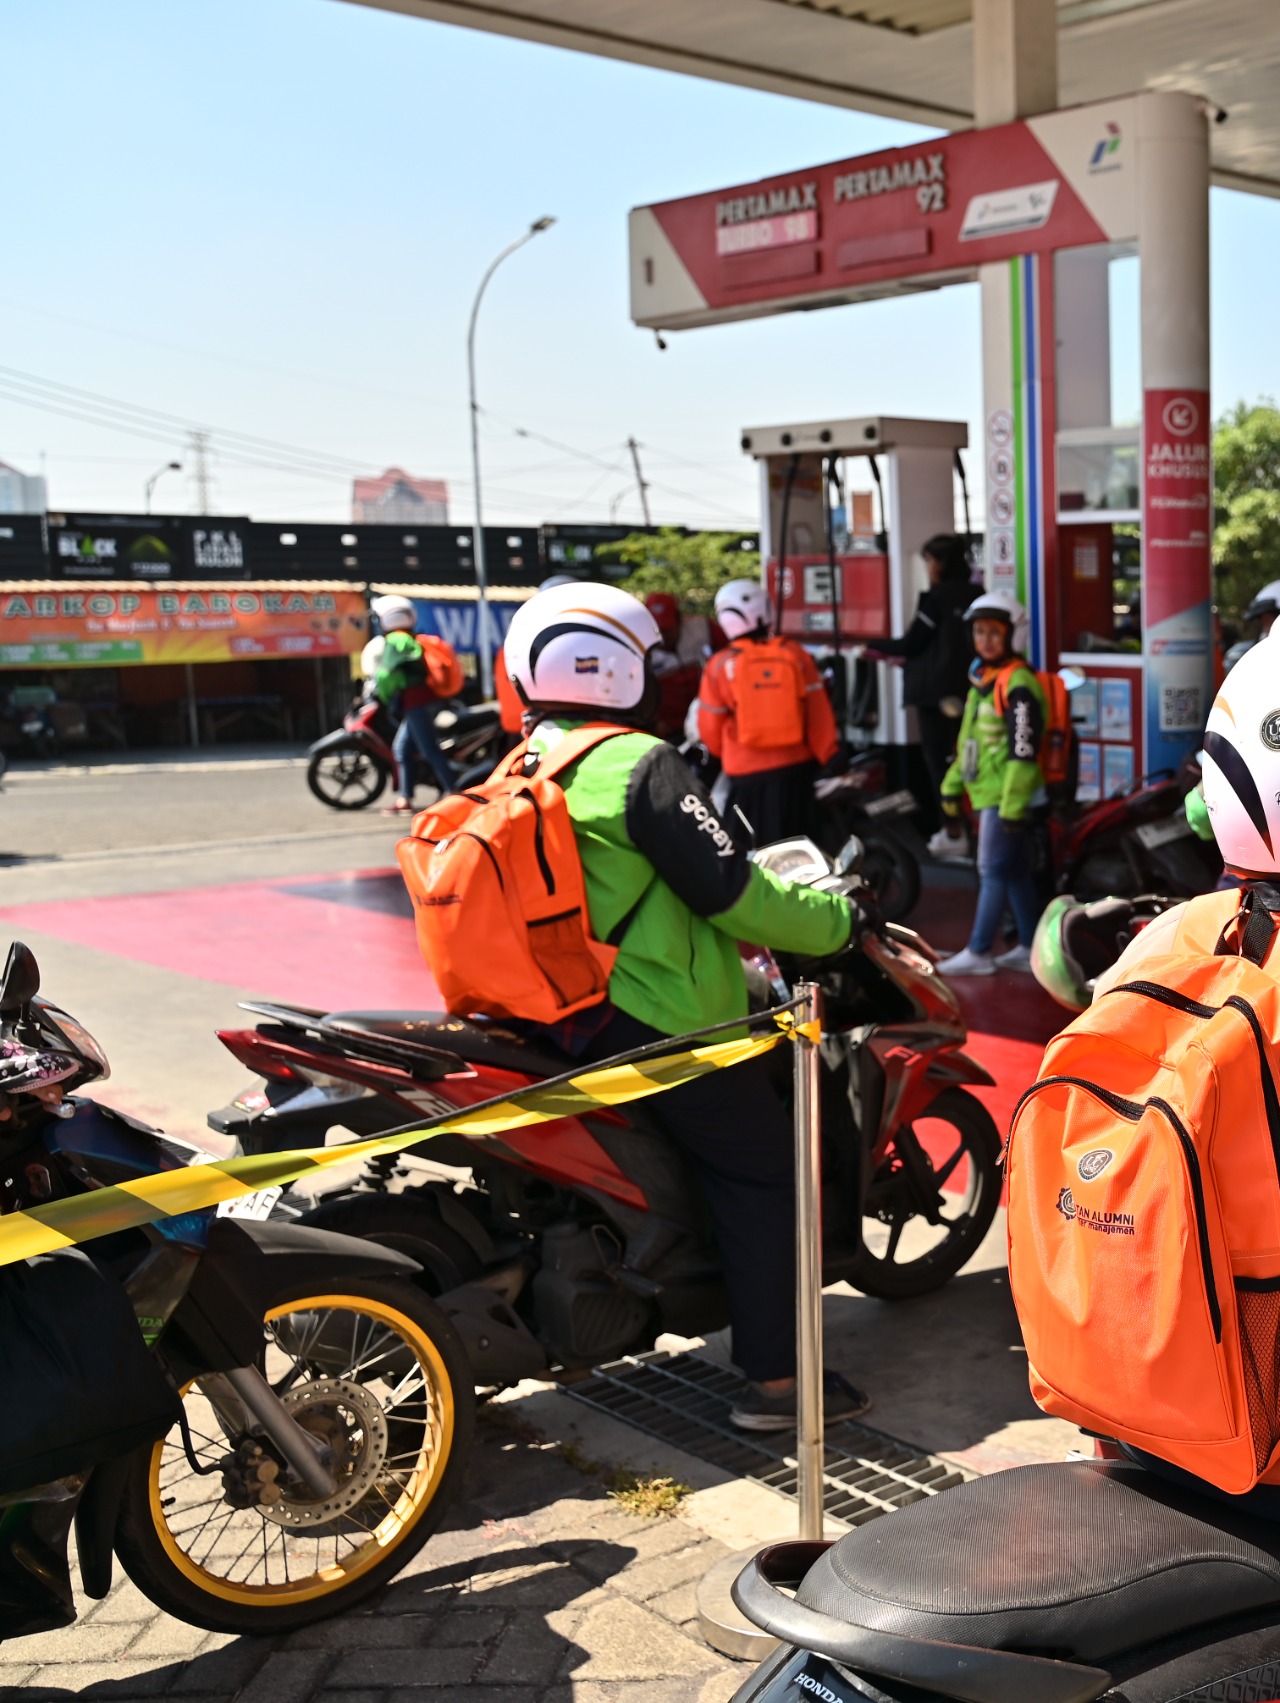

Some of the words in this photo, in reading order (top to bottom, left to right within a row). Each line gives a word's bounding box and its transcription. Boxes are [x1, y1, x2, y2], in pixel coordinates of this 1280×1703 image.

[834, 154, 944, 202] PERTAMAX
[716, 183, 817, 225] PERTAMAX
[917, 184, 944, 211] 92
[1148, 443, 1208, 462] JALUR
[1148, 463, 1208, 479] KHUSUS
[157, 592, 336, 616] BAROKAH
[1013, 700, 1034, 757] gojek
[680, 794, 735, 857] gopay
[1075, 1204, 1090, 1219] TAN
[1091, 1210, 1135, 1226] ALUMNI
[1088, 1222, 1135, 1235] manajemen
